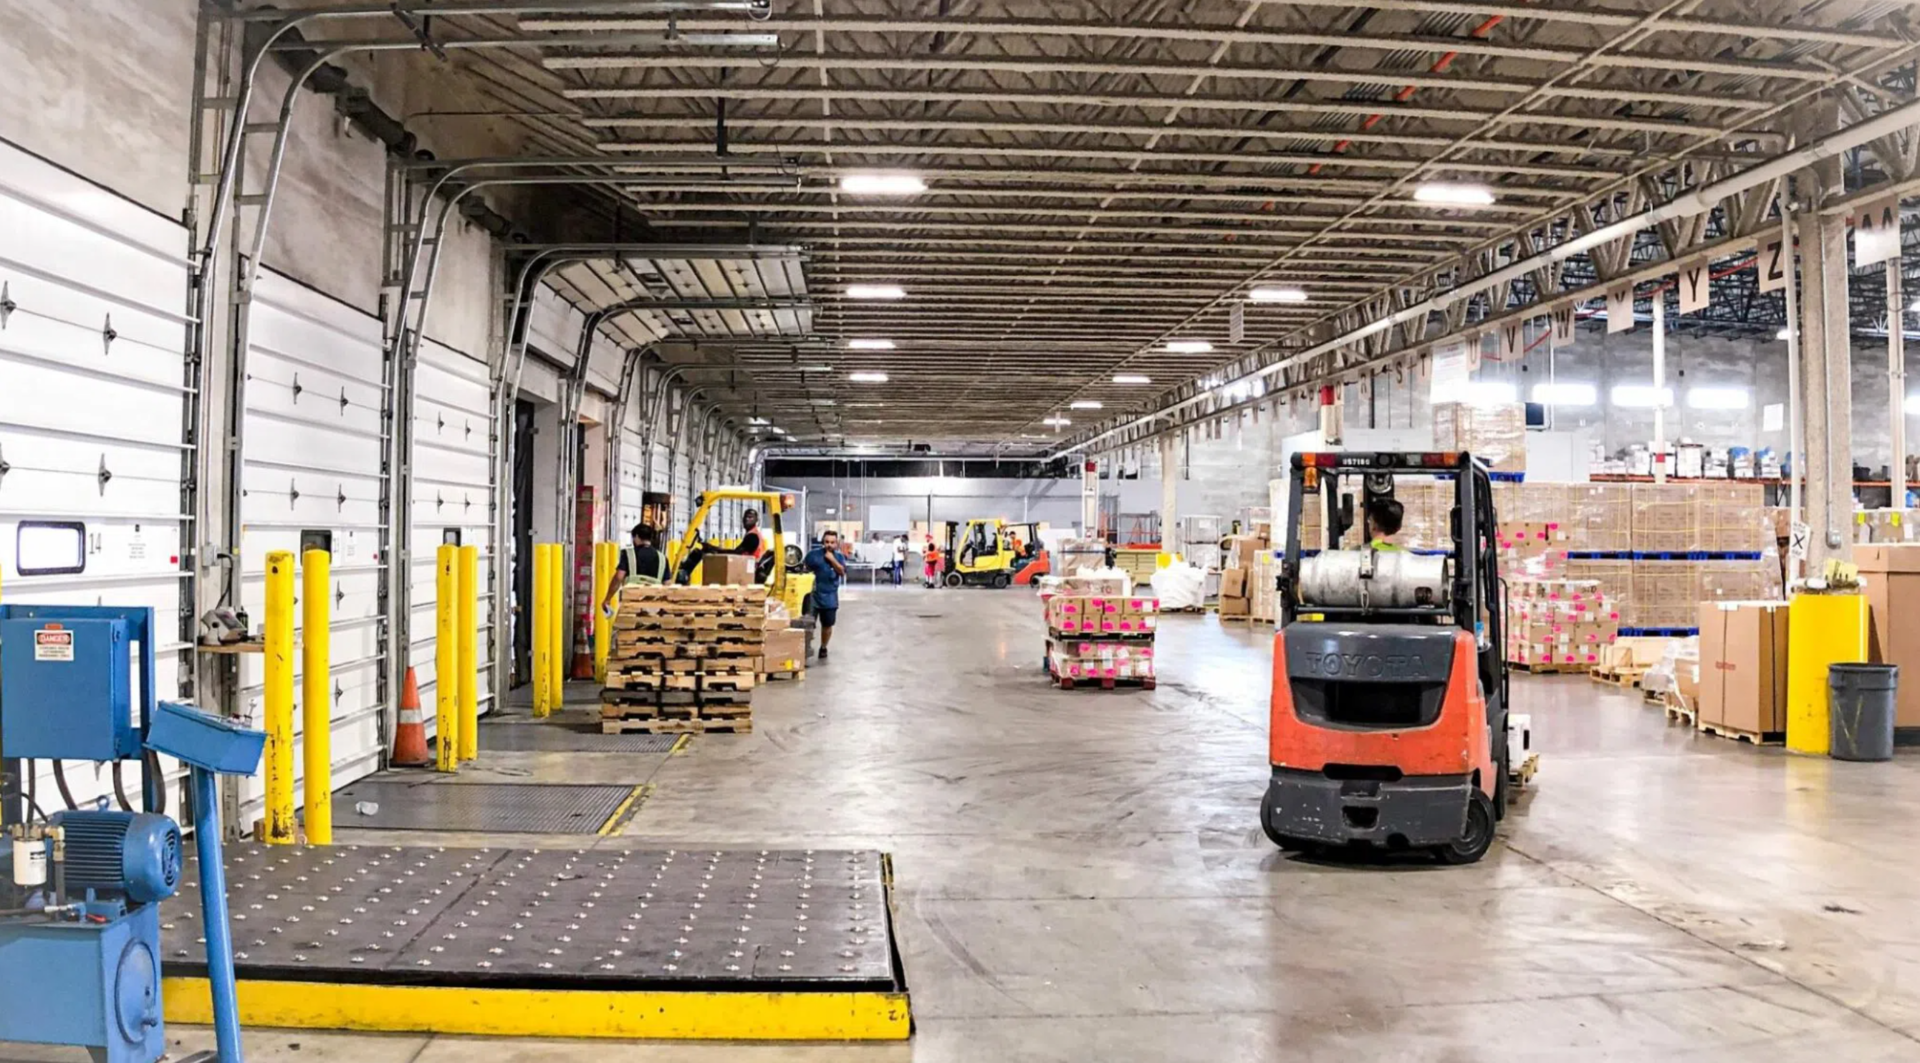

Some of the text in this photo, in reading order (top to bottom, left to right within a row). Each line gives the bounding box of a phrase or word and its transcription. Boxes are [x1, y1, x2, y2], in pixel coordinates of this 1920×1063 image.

[1767, 240, 1783, 281] Z
[1688, 267, 1700, 302] Y
[1555, 308, 1571, 339] W
[1506, 325, 1516, 353] V
[89, 533, 102, 554] 14
[1792, 533, 1806, 549] X
[1306, 651, 1429, 678] TOYOTA
